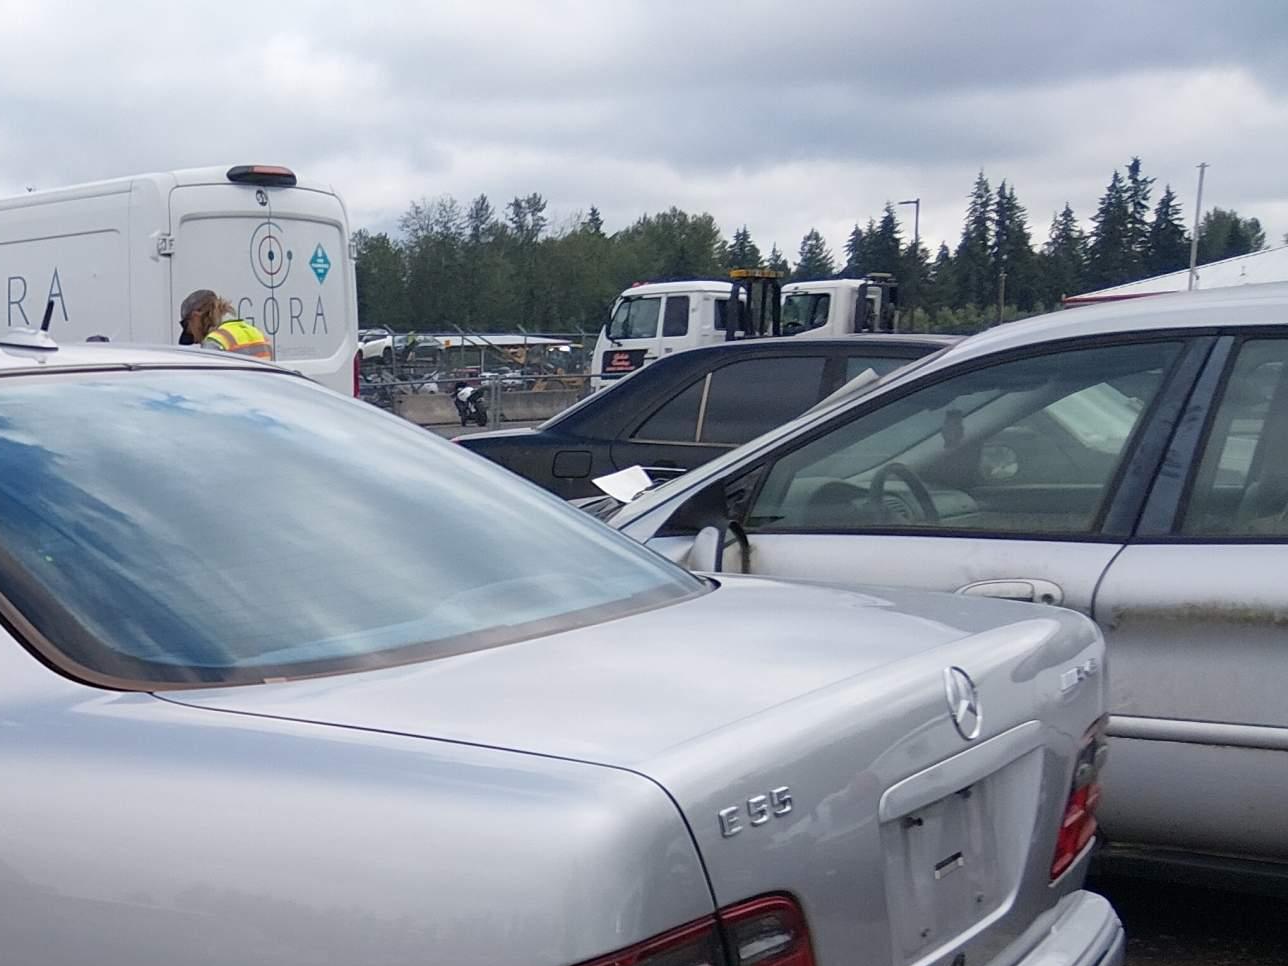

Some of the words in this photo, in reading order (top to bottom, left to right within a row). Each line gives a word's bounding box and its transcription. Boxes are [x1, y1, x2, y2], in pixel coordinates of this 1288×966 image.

[237, 295, 328, 335] GORA
[718, 806, 744, 838] E
[746, 786, 792, 827] 55
